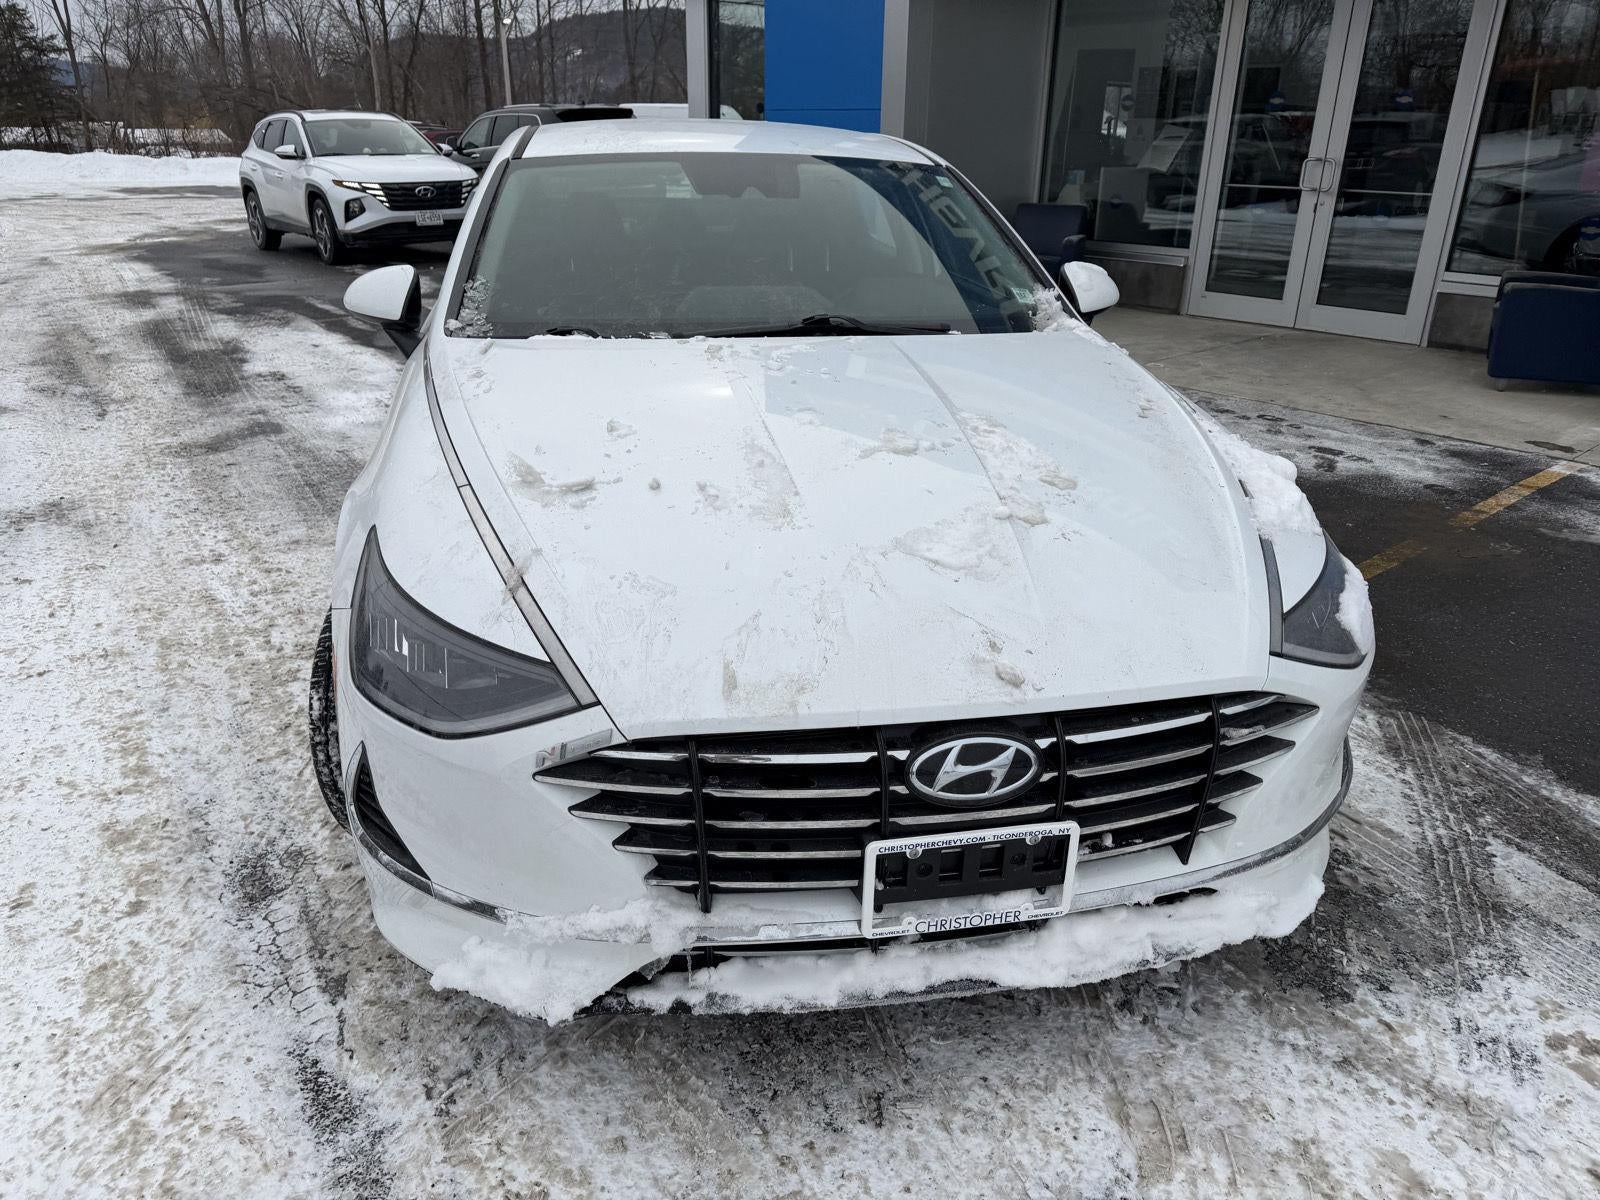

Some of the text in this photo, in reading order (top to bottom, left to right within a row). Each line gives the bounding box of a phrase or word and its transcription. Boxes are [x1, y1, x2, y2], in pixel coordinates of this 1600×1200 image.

[878, 836, 985, 853] CHRISTOPHERCHEVY.COM
[992, 829, 1054, 841] TICONDEROGA,
[1058, 827, 1071, 835] NY
[871, 910, 1064, 937] CHEVROLET CHRISTOPHER CHEVROLET
